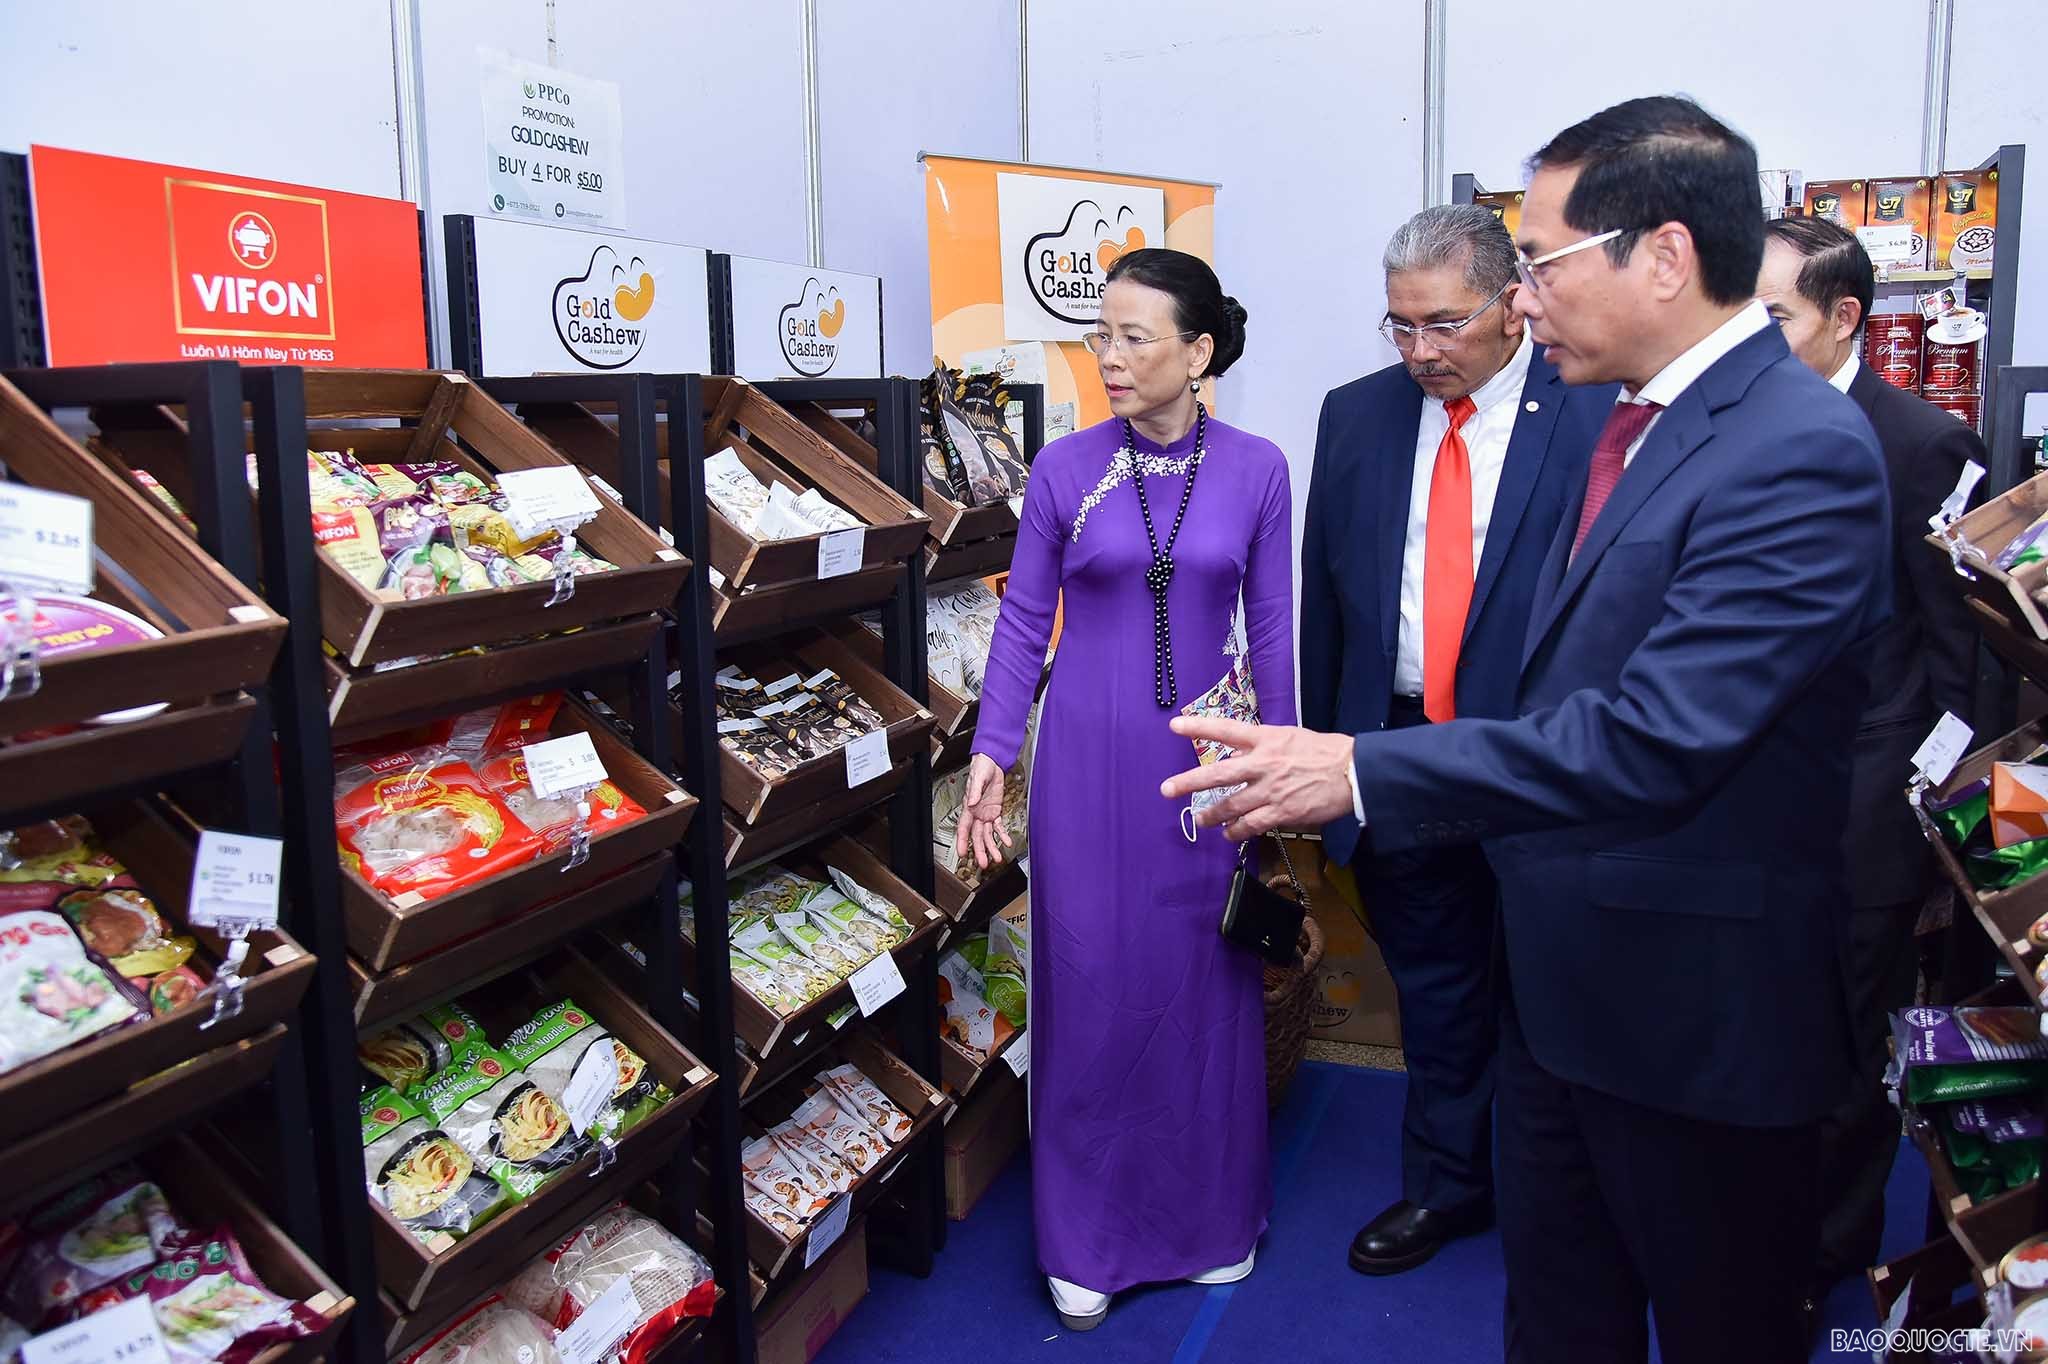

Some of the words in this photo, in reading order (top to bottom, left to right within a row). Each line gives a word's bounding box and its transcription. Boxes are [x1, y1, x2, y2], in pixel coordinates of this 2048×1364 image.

[537, 83, 570, 106] PPCo
[522, 105, 576, 128] PROMOTION:
[498, 155, 527, 176] BUY
[532, 162, 543, 180] 4
[546, 164, 572, 185] FOR
[577, 171, 603, 190] $5.00
[1040, 249, 1093, 274] Gold
[192, 273, 318, 318] VIFON
[566, 294, 612, 320] Gold
[568, 320, 640, 346] Cashew
[787, 317, 817, 337] Gold
[181, 343, 215, 358] Luôn
[233, 345, 262, 359] Hôm
[264, 347, 288, 362] Nay
[308, 349, 334, 362] 1963
[788, 337, 835, 358] Cashew
[1876, 344, 1917, 355] Premium
[1928, 343, 1968, 355] Premium
[314, 525, 355, 540] VIFON
